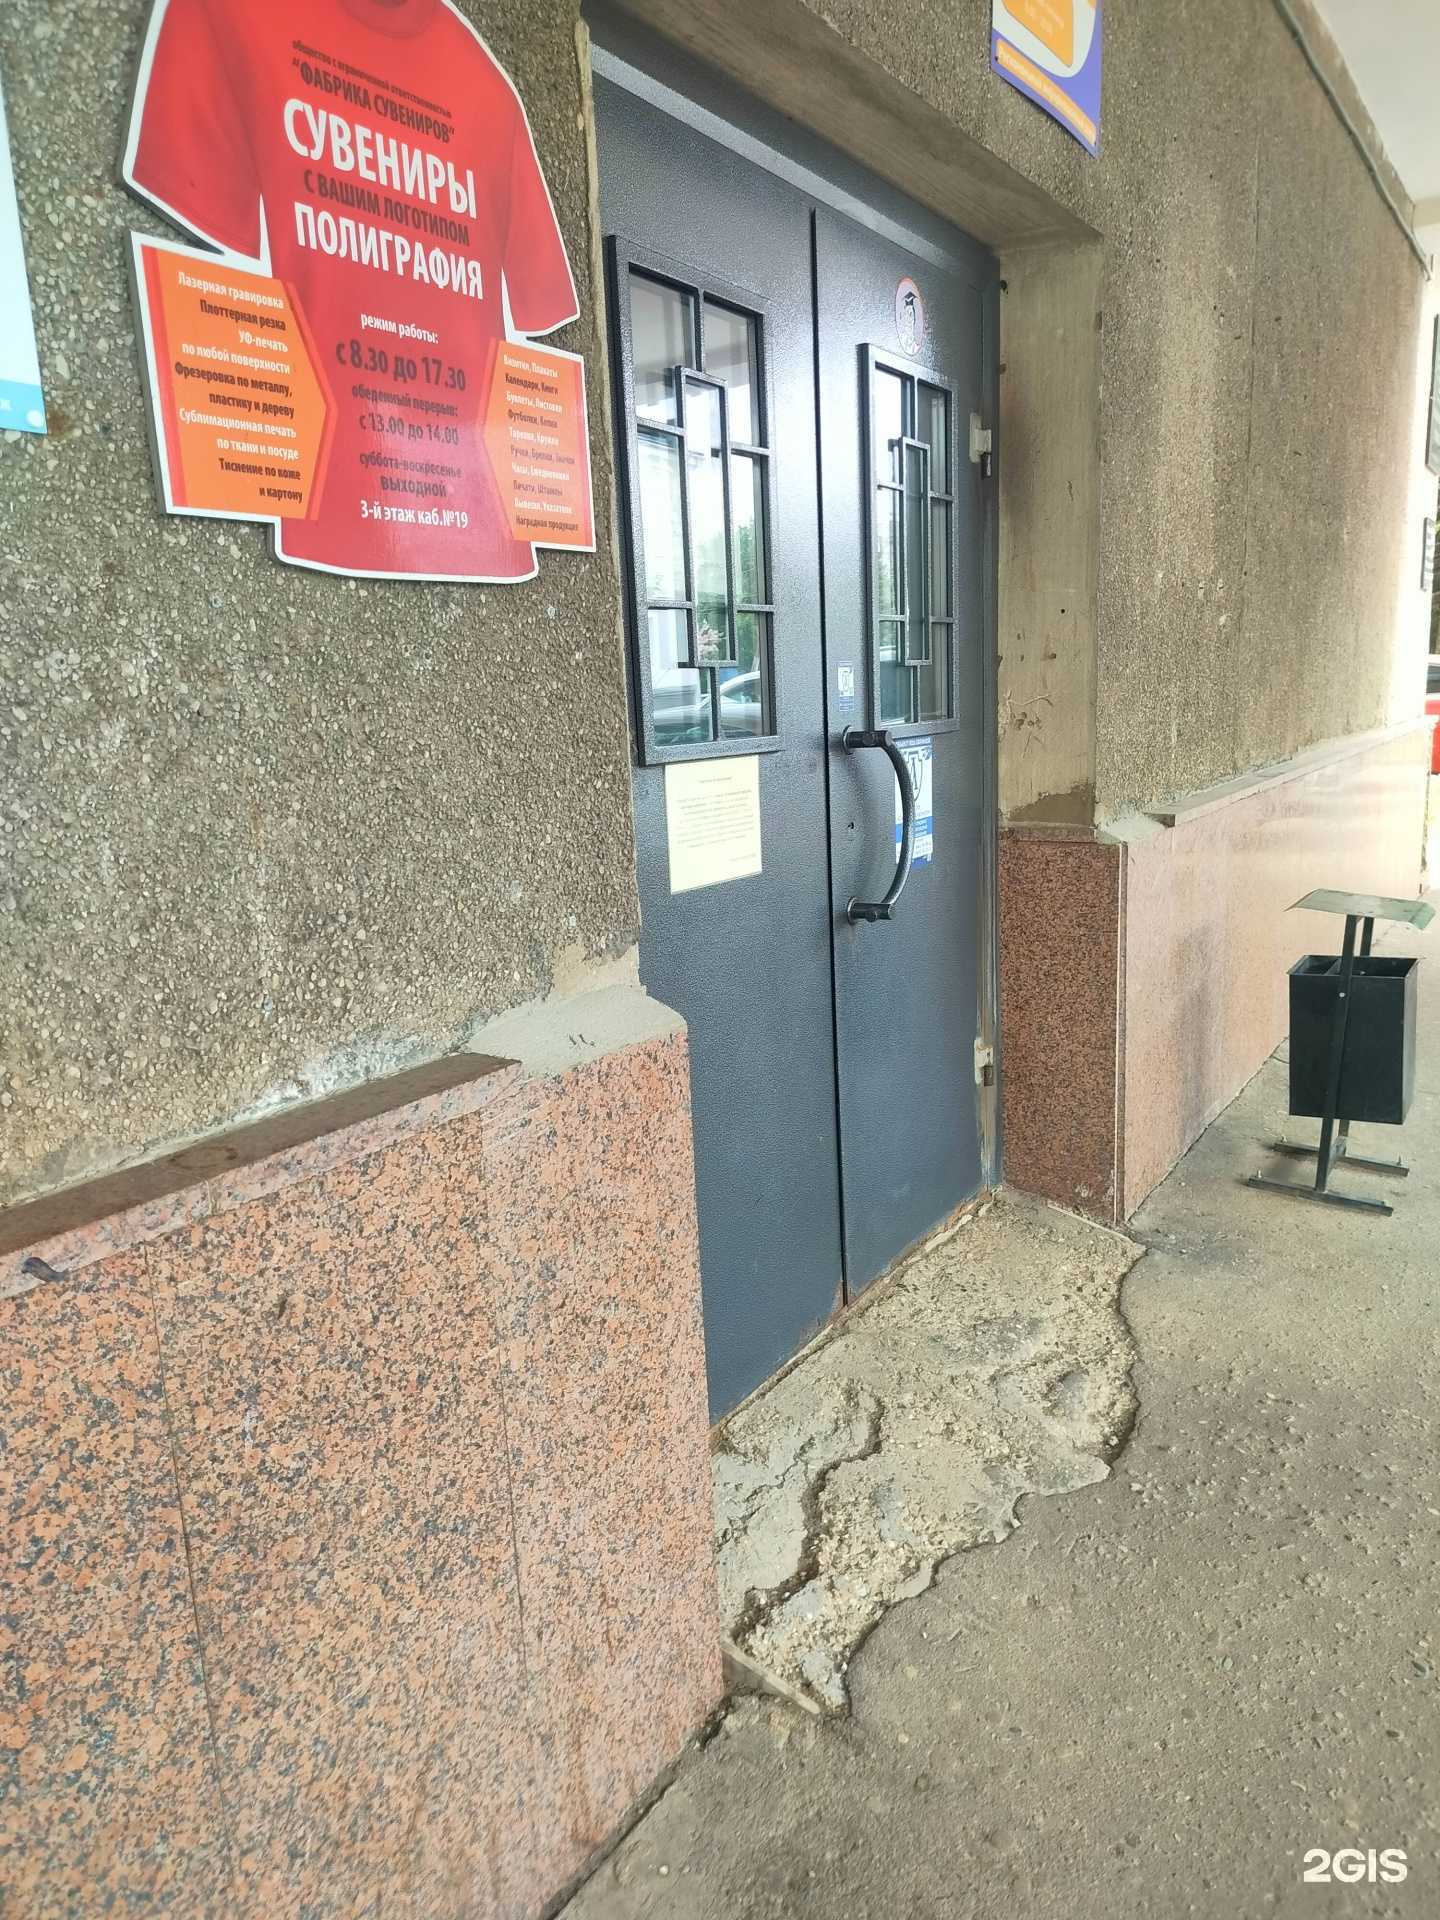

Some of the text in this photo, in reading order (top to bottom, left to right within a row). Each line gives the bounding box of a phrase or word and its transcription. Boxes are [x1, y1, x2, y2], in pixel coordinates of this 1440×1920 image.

[284, 98, 477, 219] СУВЕНИРЫ
[317, 173, 381, 216] ВАШИМ
[384, 196, 470, 247] ЛОГОТИПОМ
[294, 201, 483, 300] ПОЛИГРАФИЯ
[178, 271, 284, 309] Лазерная гравировка
[200, 299, 286, 331] Плоттерная резка
[361, 313, 439, 344] режим работы:
[239, 330, 288, 353] УФ-печать
[182, 343, 290, 374] по любой поверхности
[350, 339, 388, 374] 8.30
[393, 356, 417, 384] до
[422, 356, 466, 391] 17.30
[175, 361, 293, 398] Фрезеровка по металлу,
[209, 393, 295, 418] пластику и дереву
[352, 384, 458, 417] обеденный перерыв:
[180, 407, 297, 438] Сублимационная печать
[368, 412, 405, 436] 13.00
[408, 423, 424, 442] до
[217, 438, 299, 461] по ткани и посуде
[359, 451, 463, 479] суббота-воскресенье
[219, 458, 301, 480] Тиснение по коже
[259, 487, 303, 503] и картону
[360, 500, 382, 519] 3-й
[383, 506, 416, 523] этаж
